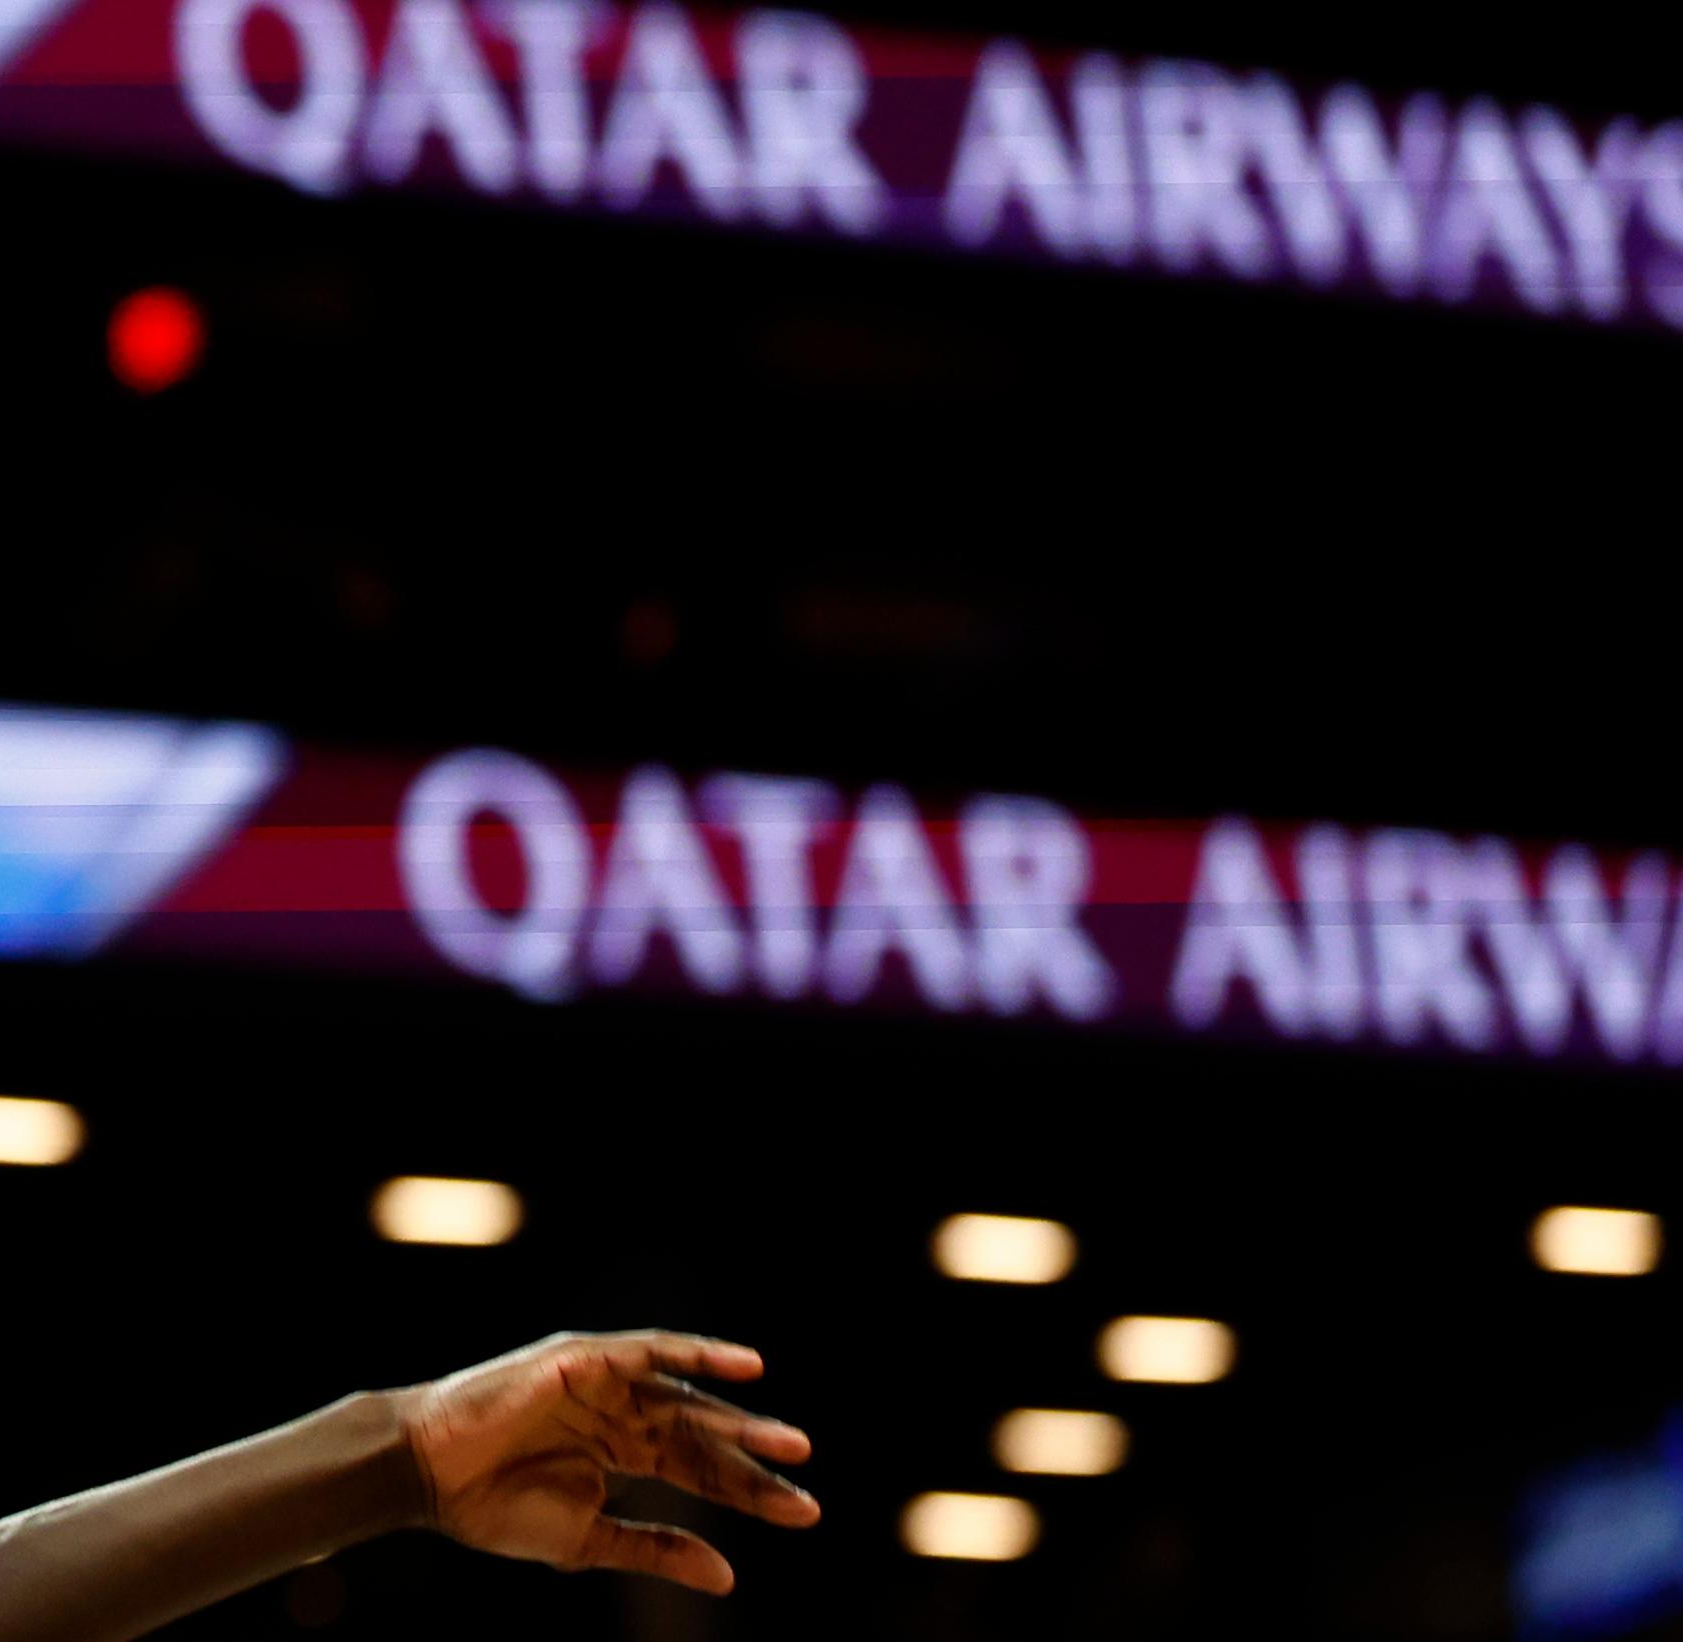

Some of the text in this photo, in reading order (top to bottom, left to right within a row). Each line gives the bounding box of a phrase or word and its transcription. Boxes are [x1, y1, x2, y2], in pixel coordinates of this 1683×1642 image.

[172, 0, 885, 234] QATAR
[398, 748, 1683, 1066] QATAR AIRW
